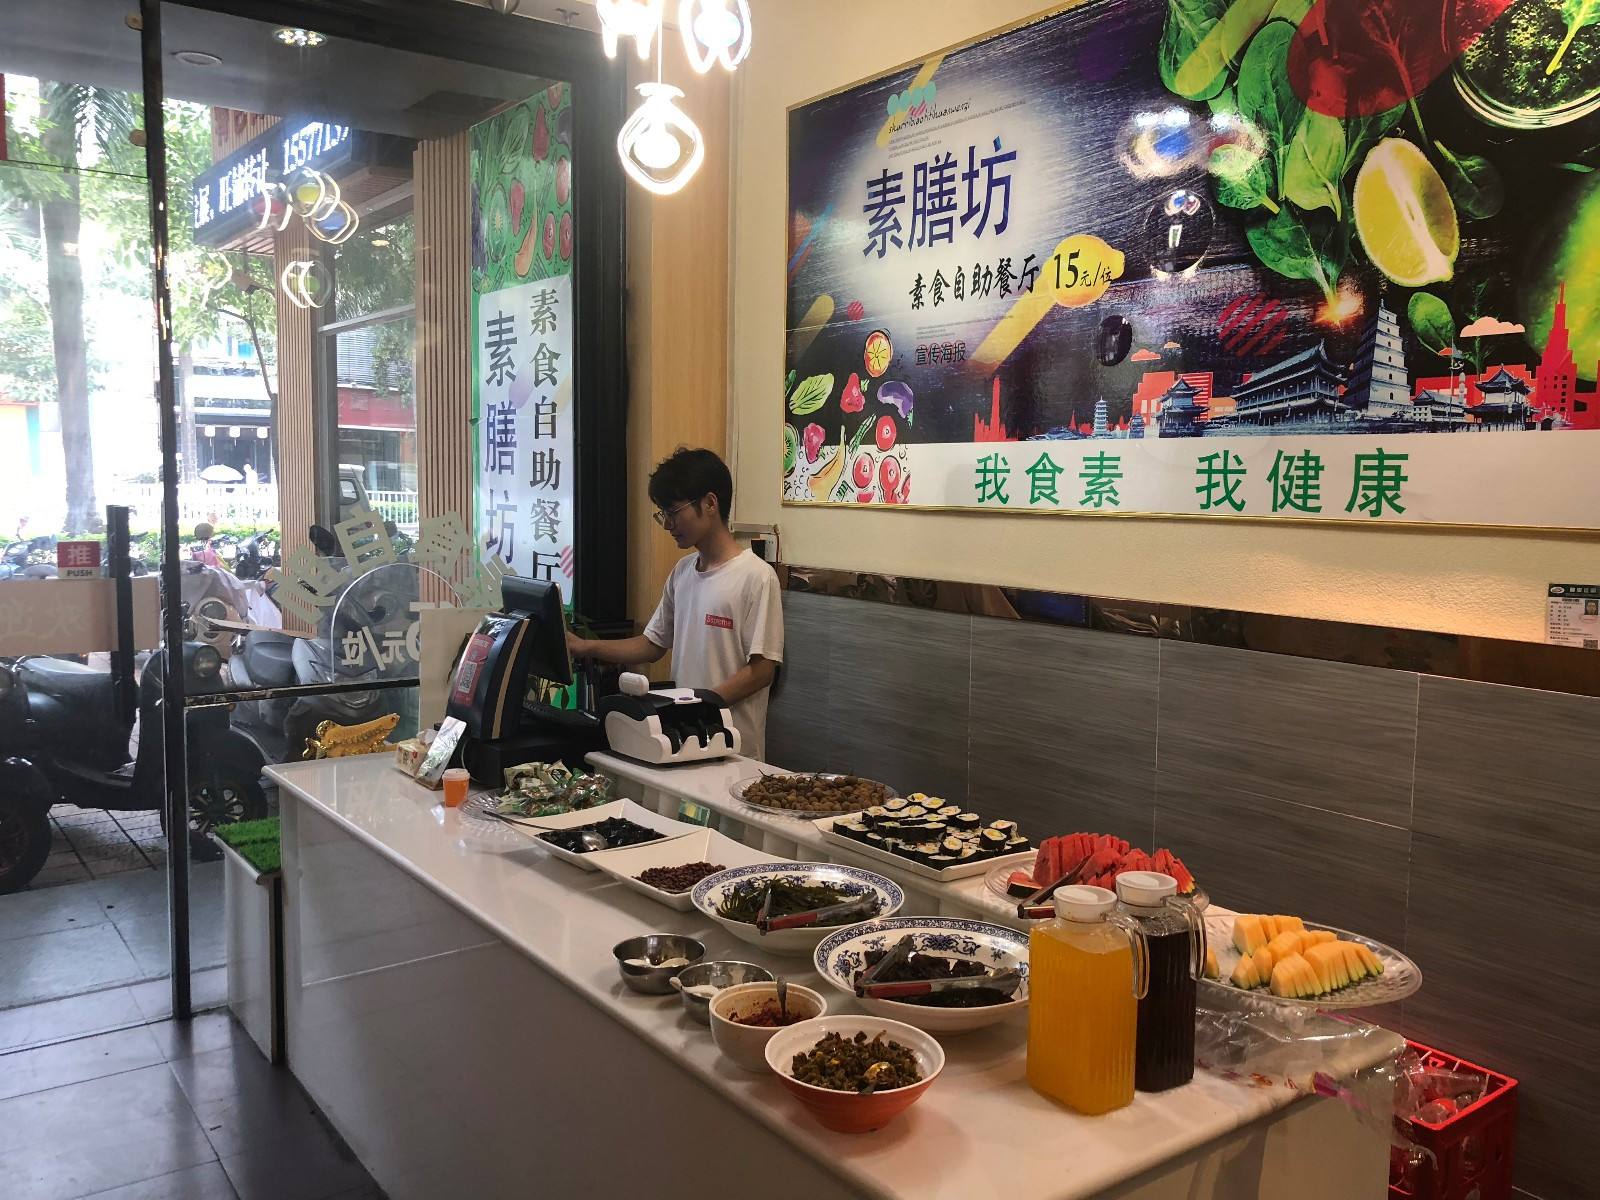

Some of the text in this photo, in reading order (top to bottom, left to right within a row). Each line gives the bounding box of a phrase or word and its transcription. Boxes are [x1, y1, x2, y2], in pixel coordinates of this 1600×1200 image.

[862, 135, 1018, 259] 素膳坊
[909, 254, 1040, 310] 素食自助餐厅
[915, 341, 966, 366] 宣传海报
[485, 310, 518, 564] 素膳坊
[529, 288, 561, 580] 素食自助餐厅
[974, 447, 1409, 518] 我食素 我健康
[67, 545, 92, 565] 推
